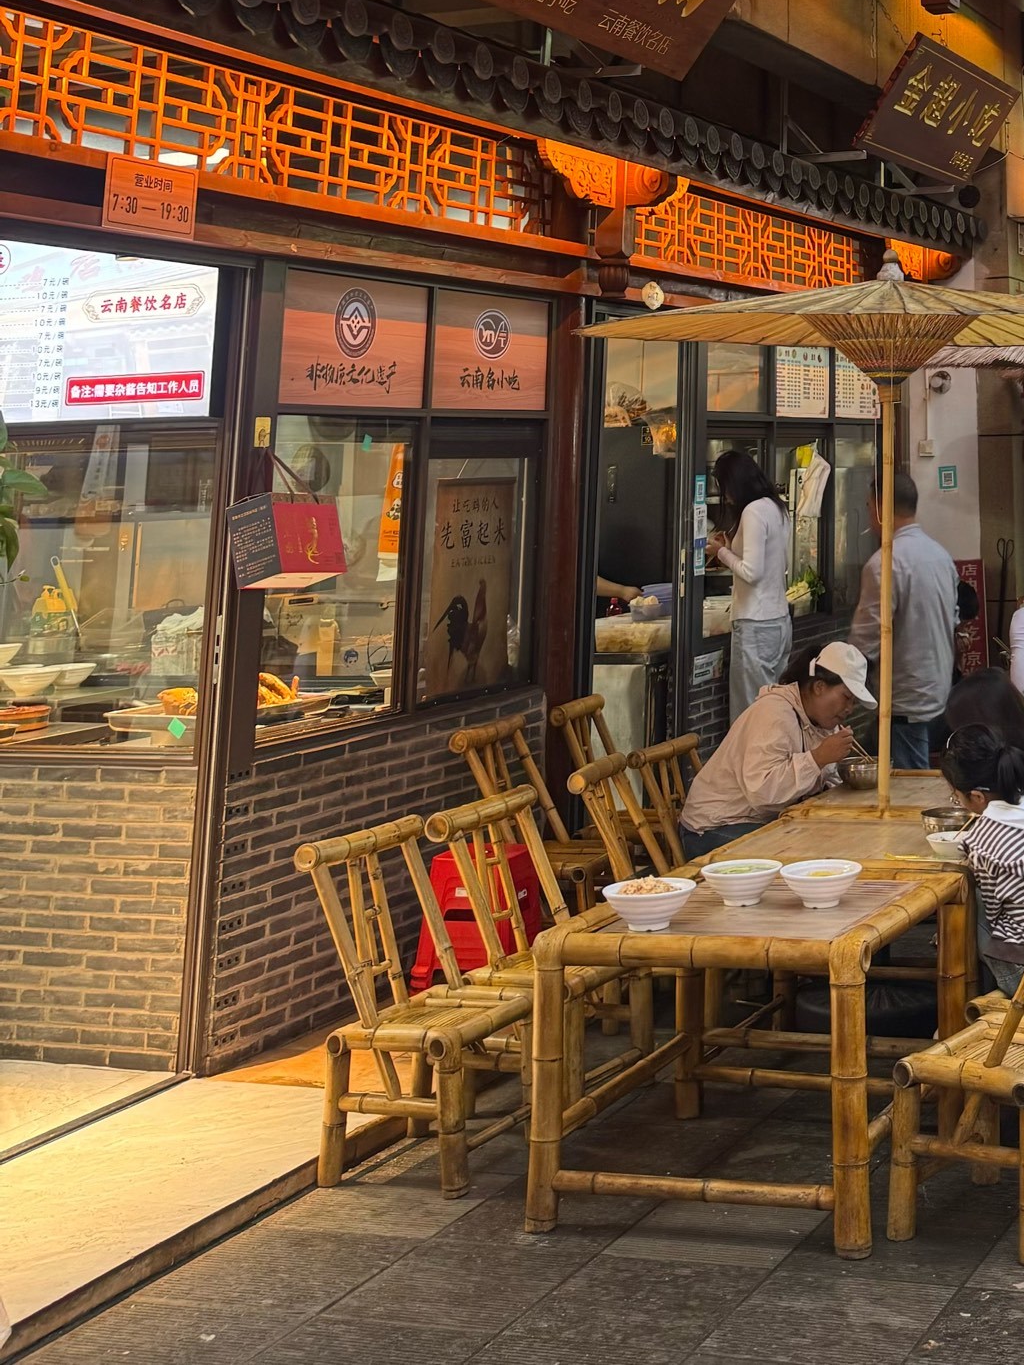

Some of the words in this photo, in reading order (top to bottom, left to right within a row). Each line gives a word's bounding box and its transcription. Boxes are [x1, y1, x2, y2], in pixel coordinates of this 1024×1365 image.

[599, 9, 675, 56] 云南餐饮名店
[134, 173, 173, 193] 营业时间
[112, 193, 138, 215] 7:30
[160, 202, 189, 223] 19:30
[100, 292, 187, 314] 云南餐饮名店
[459, 367, 520, 391] 云南名小吃
